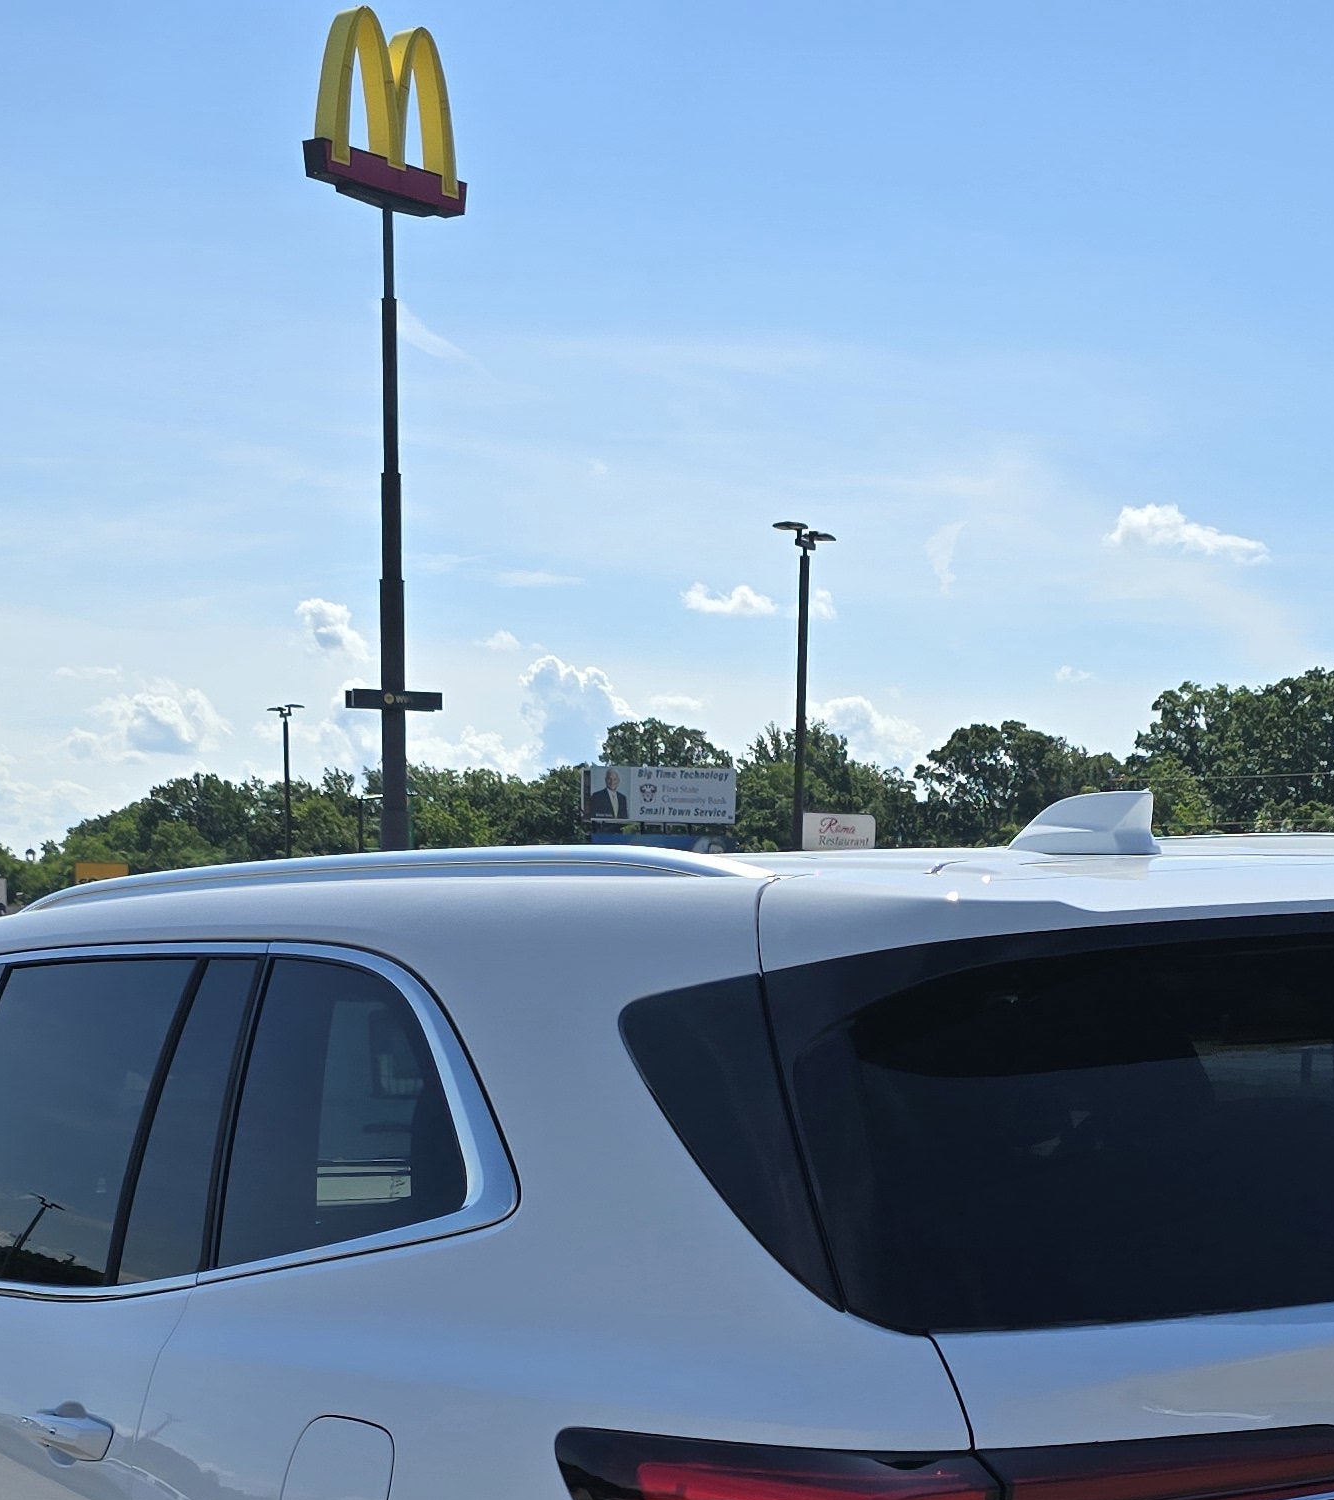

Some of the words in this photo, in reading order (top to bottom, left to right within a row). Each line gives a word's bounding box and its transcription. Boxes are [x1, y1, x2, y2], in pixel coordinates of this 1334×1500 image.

[637, 768, 652, 780] Big
[656, 769, 676, 779] Time
[680, 770, 729, 782] Technology
[661, 784, 678, 793] First
[680, 784, 699, 794] State
[661, 795, 706, 805] Community
[708, 796, 727, 805] Bank
[640, 806, 665, 816] Small
[668, 807, 691, 817] Town
[694, 808, 727, 818] Service
[819, 835, 869, 847] Restaurant
